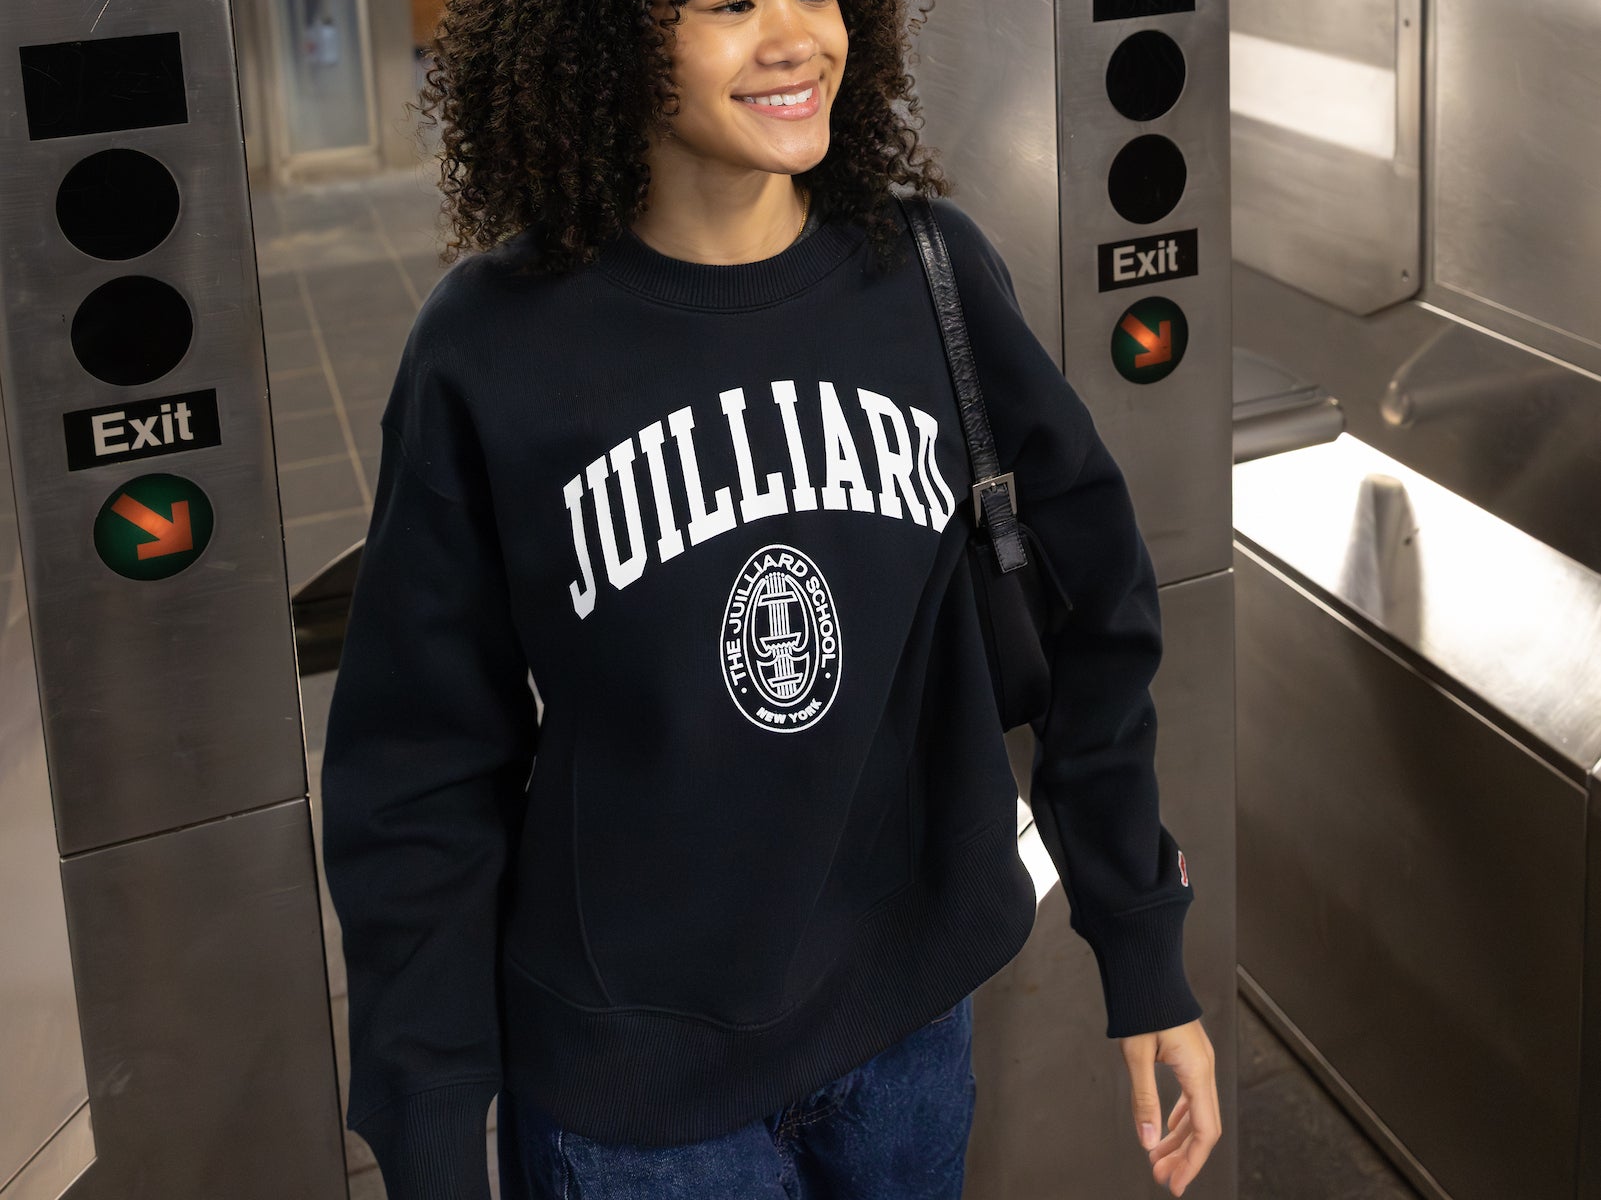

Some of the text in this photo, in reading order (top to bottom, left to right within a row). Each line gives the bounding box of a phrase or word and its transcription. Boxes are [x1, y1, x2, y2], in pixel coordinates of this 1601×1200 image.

[1112, 240, 1179, 282] Exit
[91, 402, 194, 456] Exit
[562, 379, 956, 620] JUILLIARD
[726, 552, 836, 687] THE JUILLIARD SCHOOL
[755, 698, 822, 725] NEW YORK
